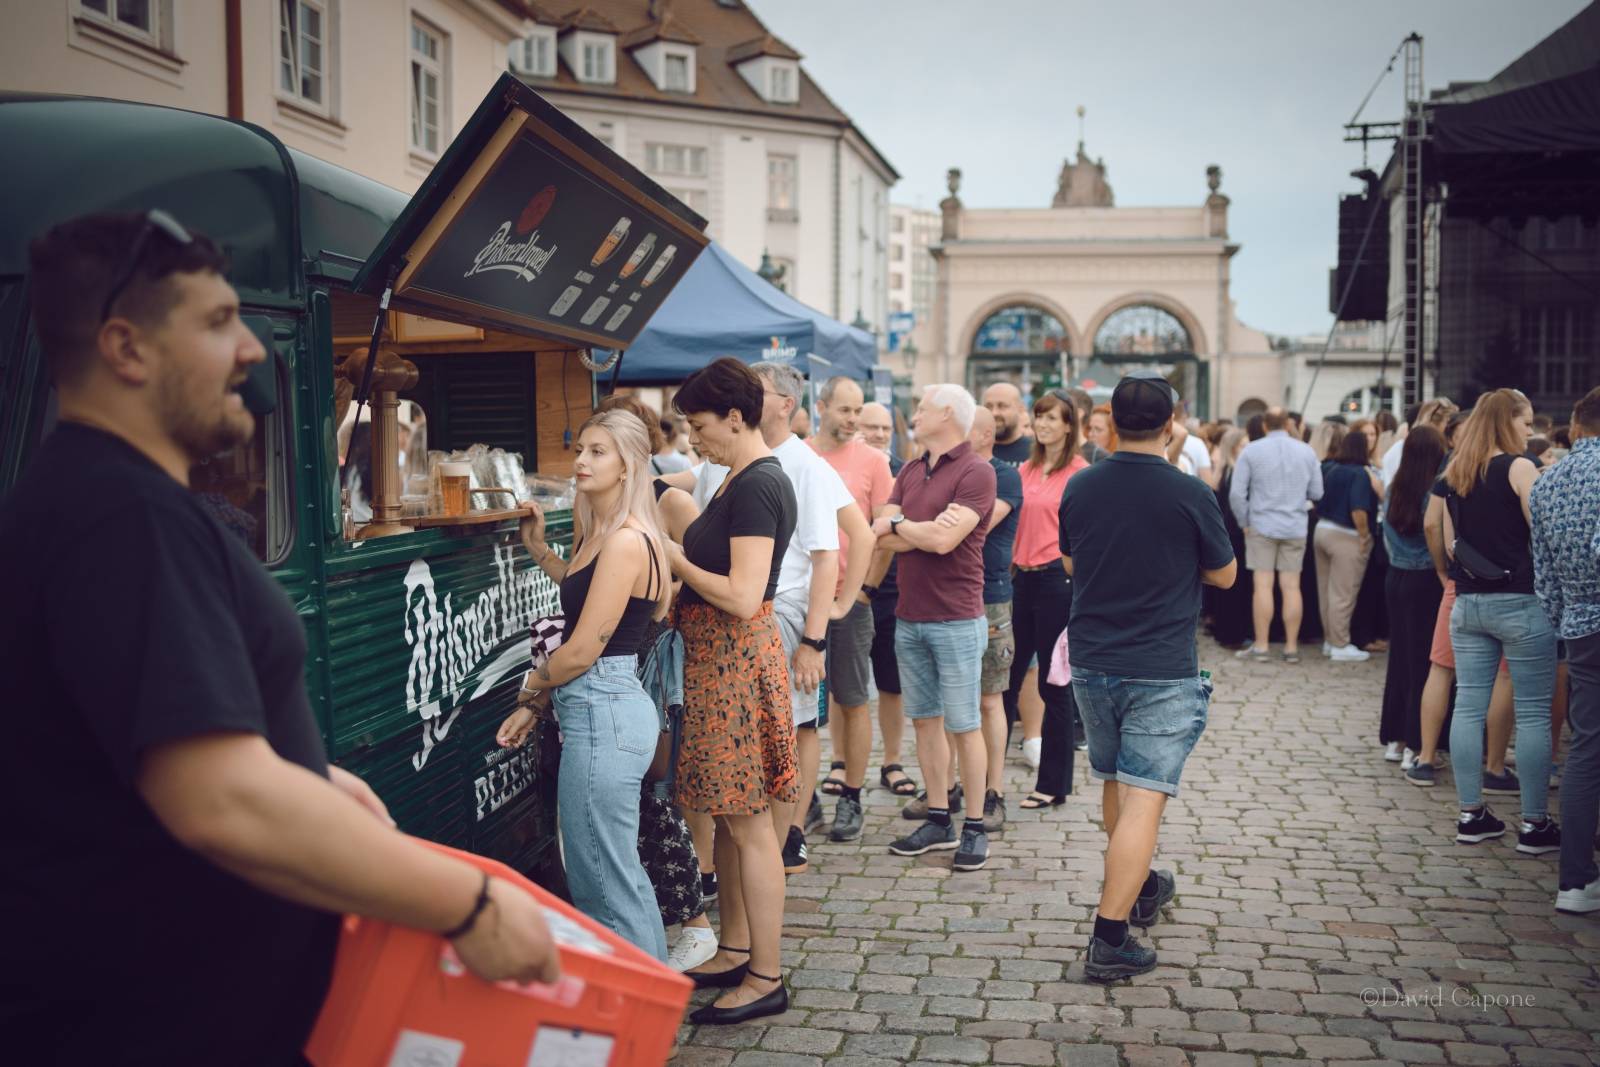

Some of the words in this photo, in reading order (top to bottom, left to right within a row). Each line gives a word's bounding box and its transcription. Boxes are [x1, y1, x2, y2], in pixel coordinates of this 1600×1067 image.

[463, 221, 527, 278] Pilsner
[515, 229, 558, 280] Urquell
[403, 558, 500, 772] Pilsner
[494, 542, 565, 640] Urquel
